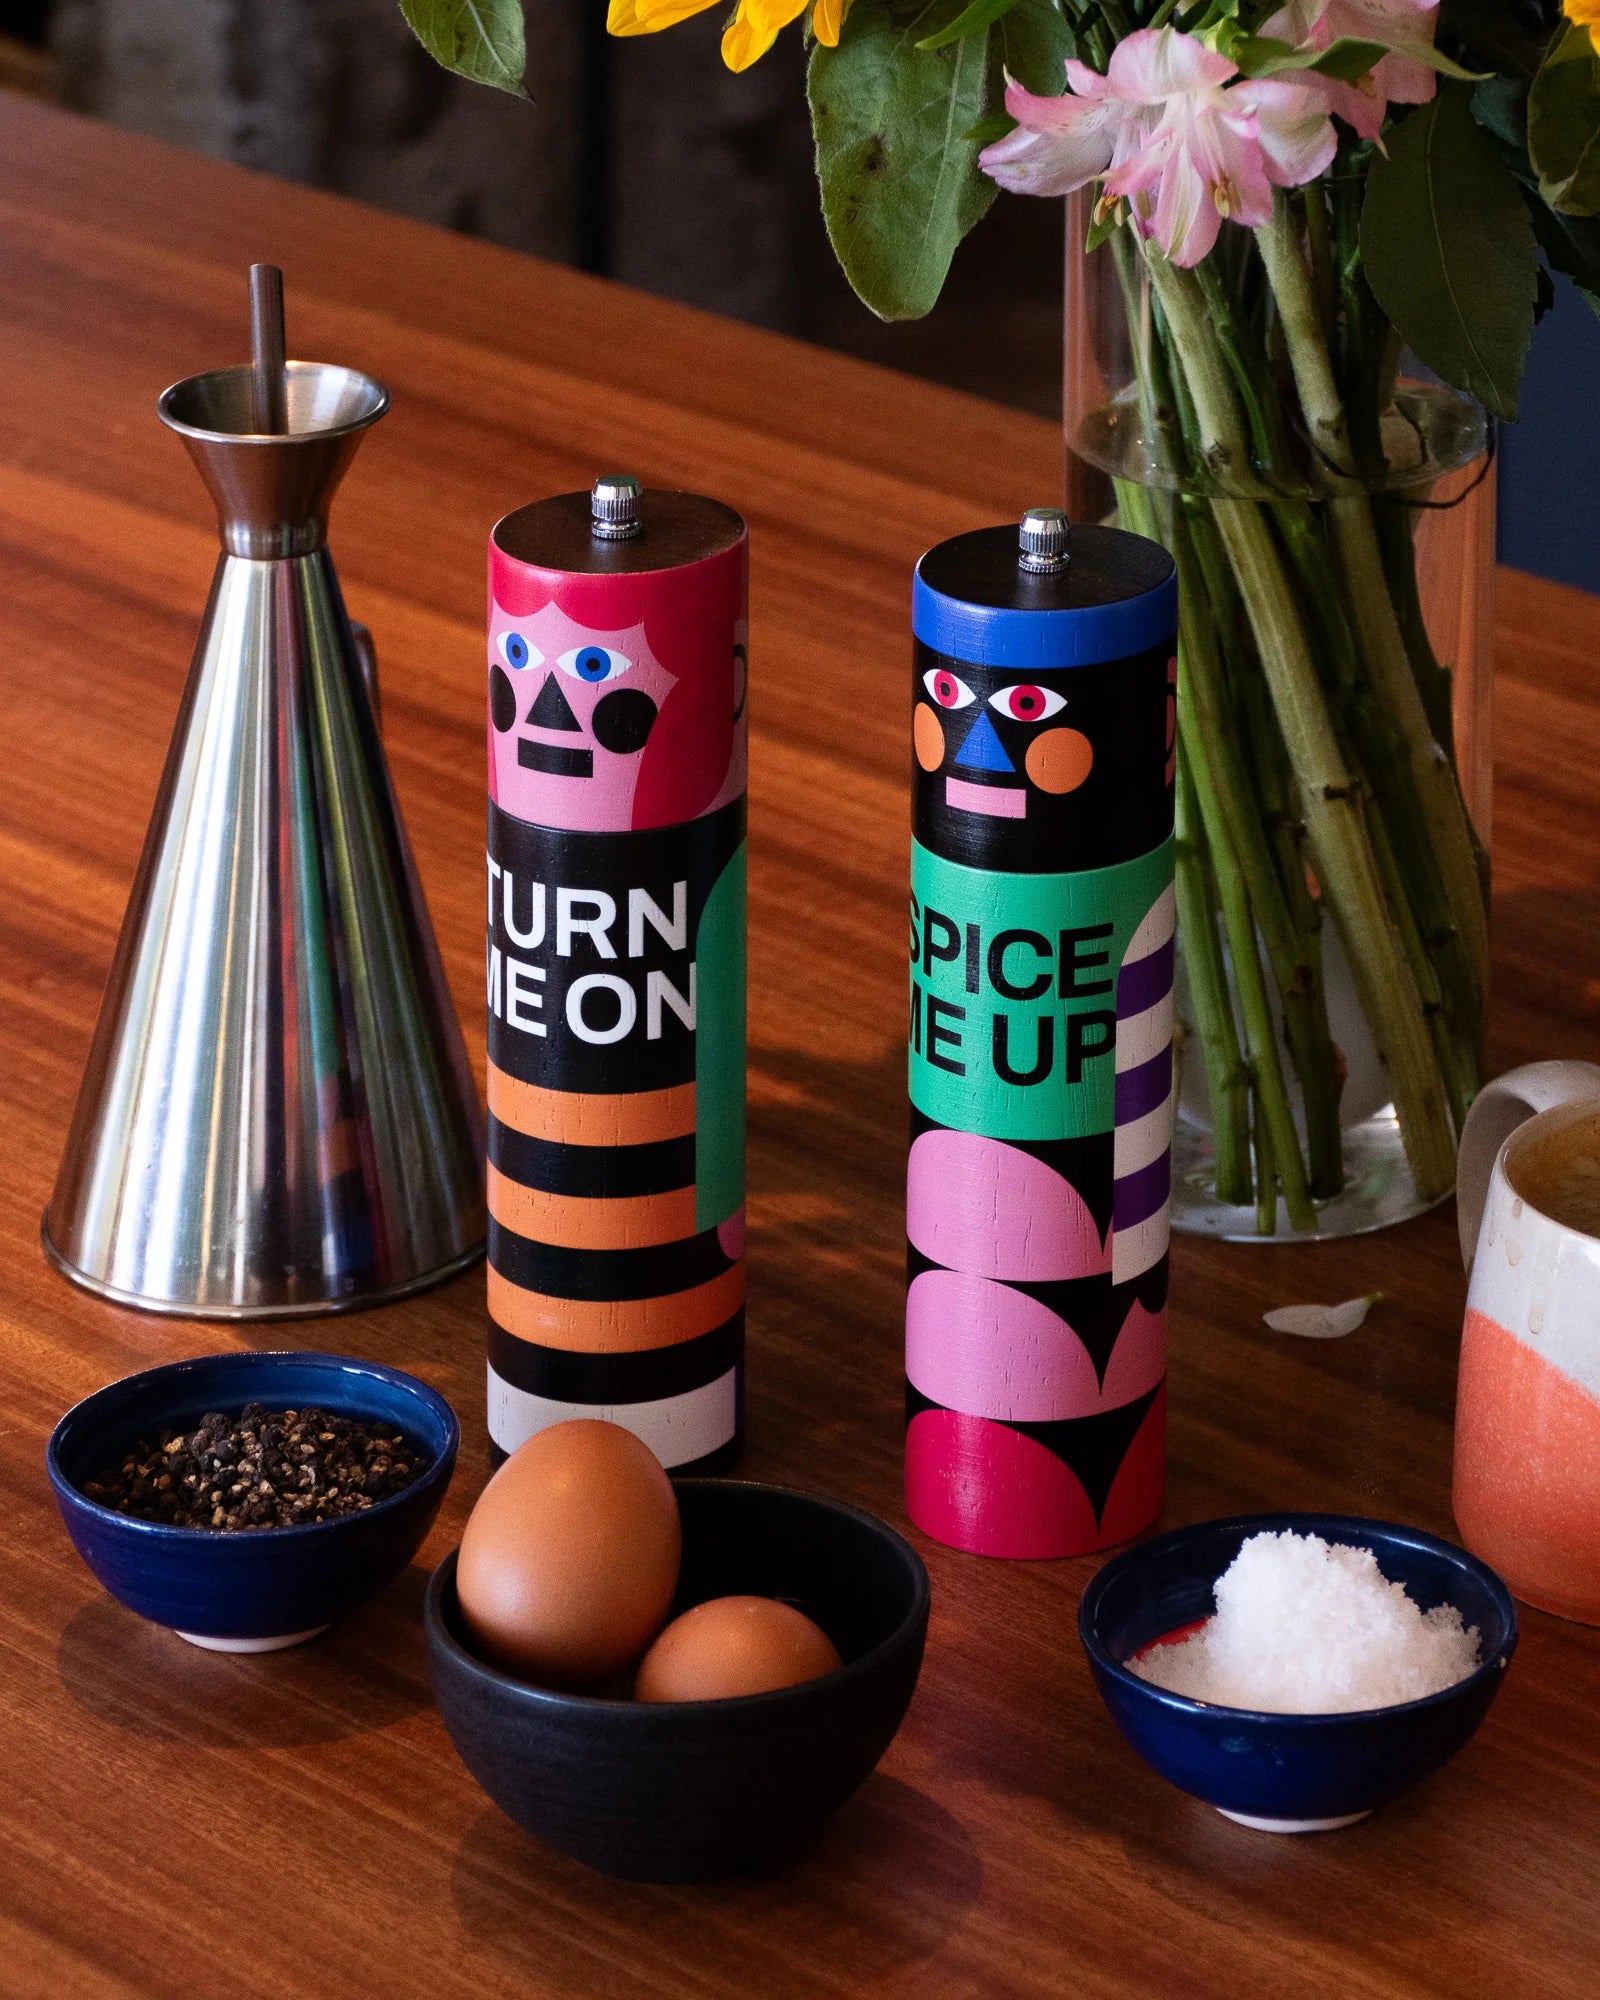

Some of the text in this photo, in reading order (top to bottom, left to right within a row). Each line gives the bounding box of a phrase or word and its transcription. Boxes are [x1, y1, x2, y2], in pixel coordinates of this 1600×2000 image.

[487, 850, 687, 959] TURN
[566, 962, 697, 1045] ON
[992, 1009, 1117, 1086] UP
